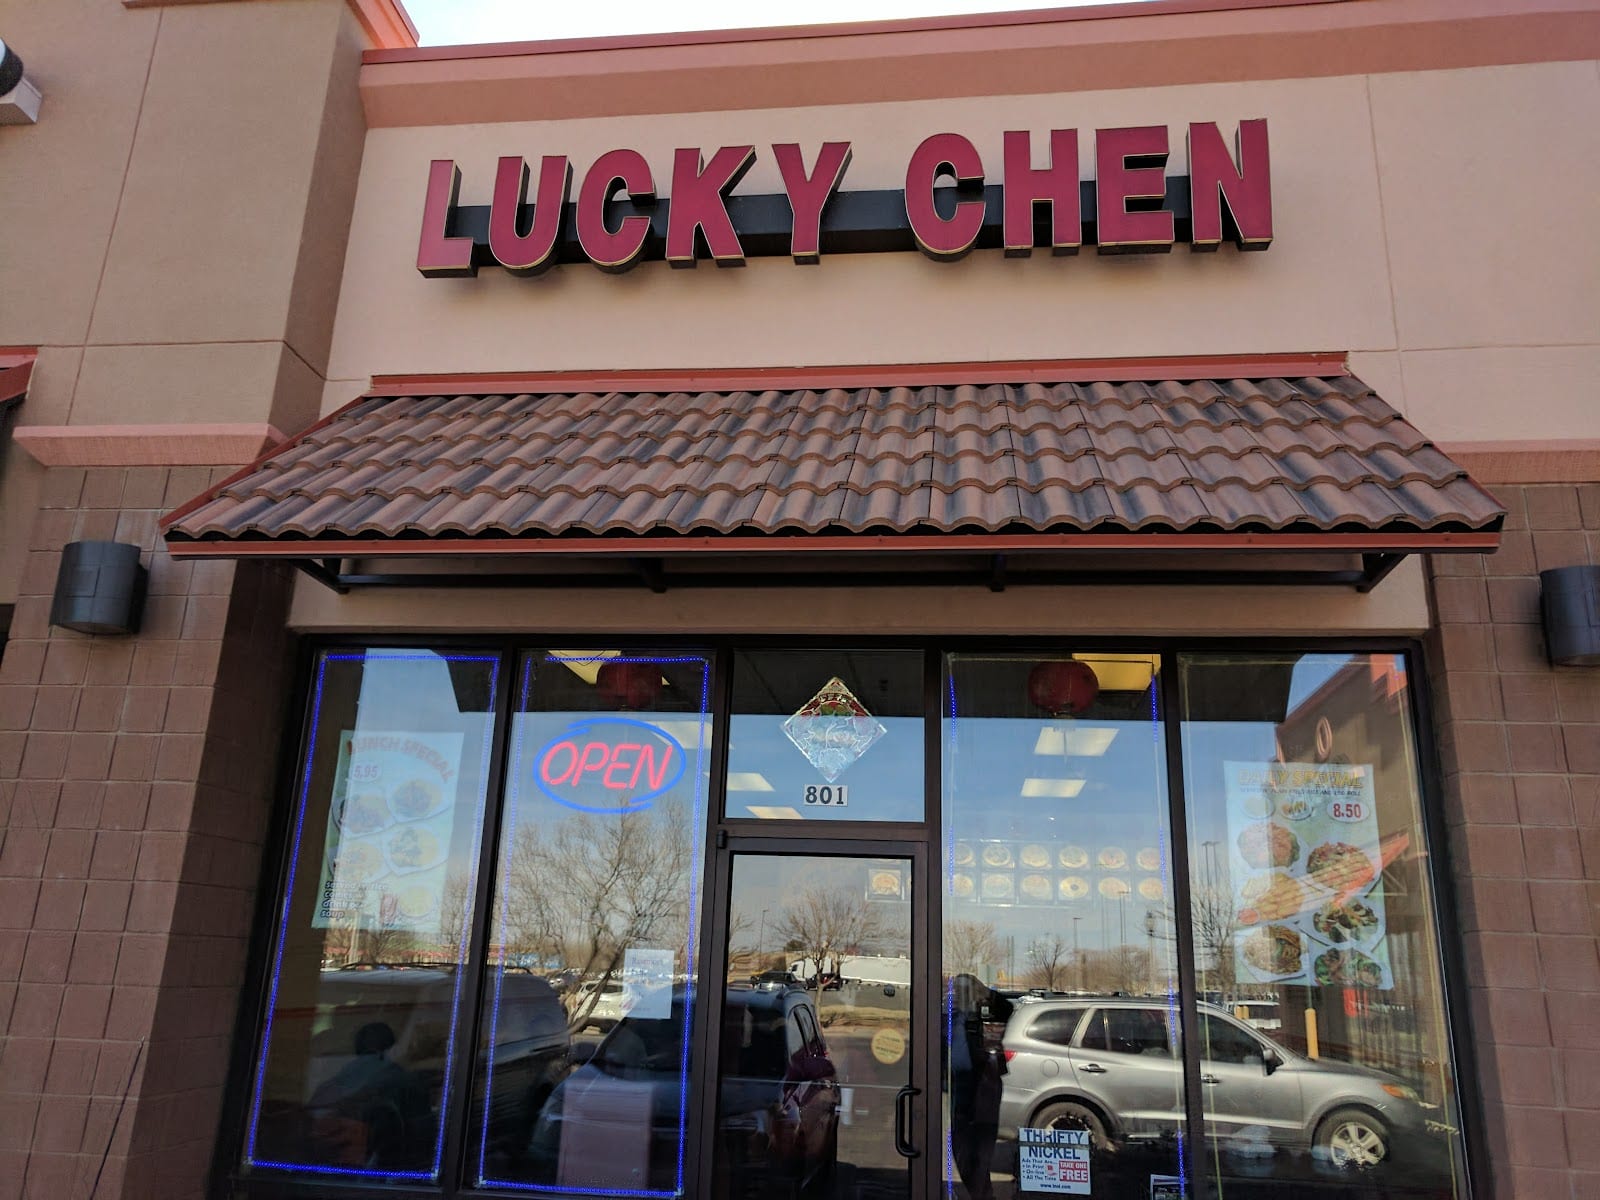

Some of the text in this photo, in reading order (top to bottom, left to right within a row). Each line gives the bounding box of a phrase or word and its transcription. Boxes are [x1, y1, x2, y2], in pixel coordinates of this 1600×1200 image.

[416, 118, 1273, 278] LUCKY CHEN
[401, 739, 455, 783] SPECIAL
[541, 741, 673, 790] OPEN
[1292, 770, 1364, 790] SPECIAL
[805, 786, 844, 805] 801
[1333, 803, 1362, 818] 8.50
[1024, 1129, 1084, 1144] THRIFTY
[1029, 1146, 1081, 1160] NICKEL
[1060, 1170, 1088, 1181] FREE
